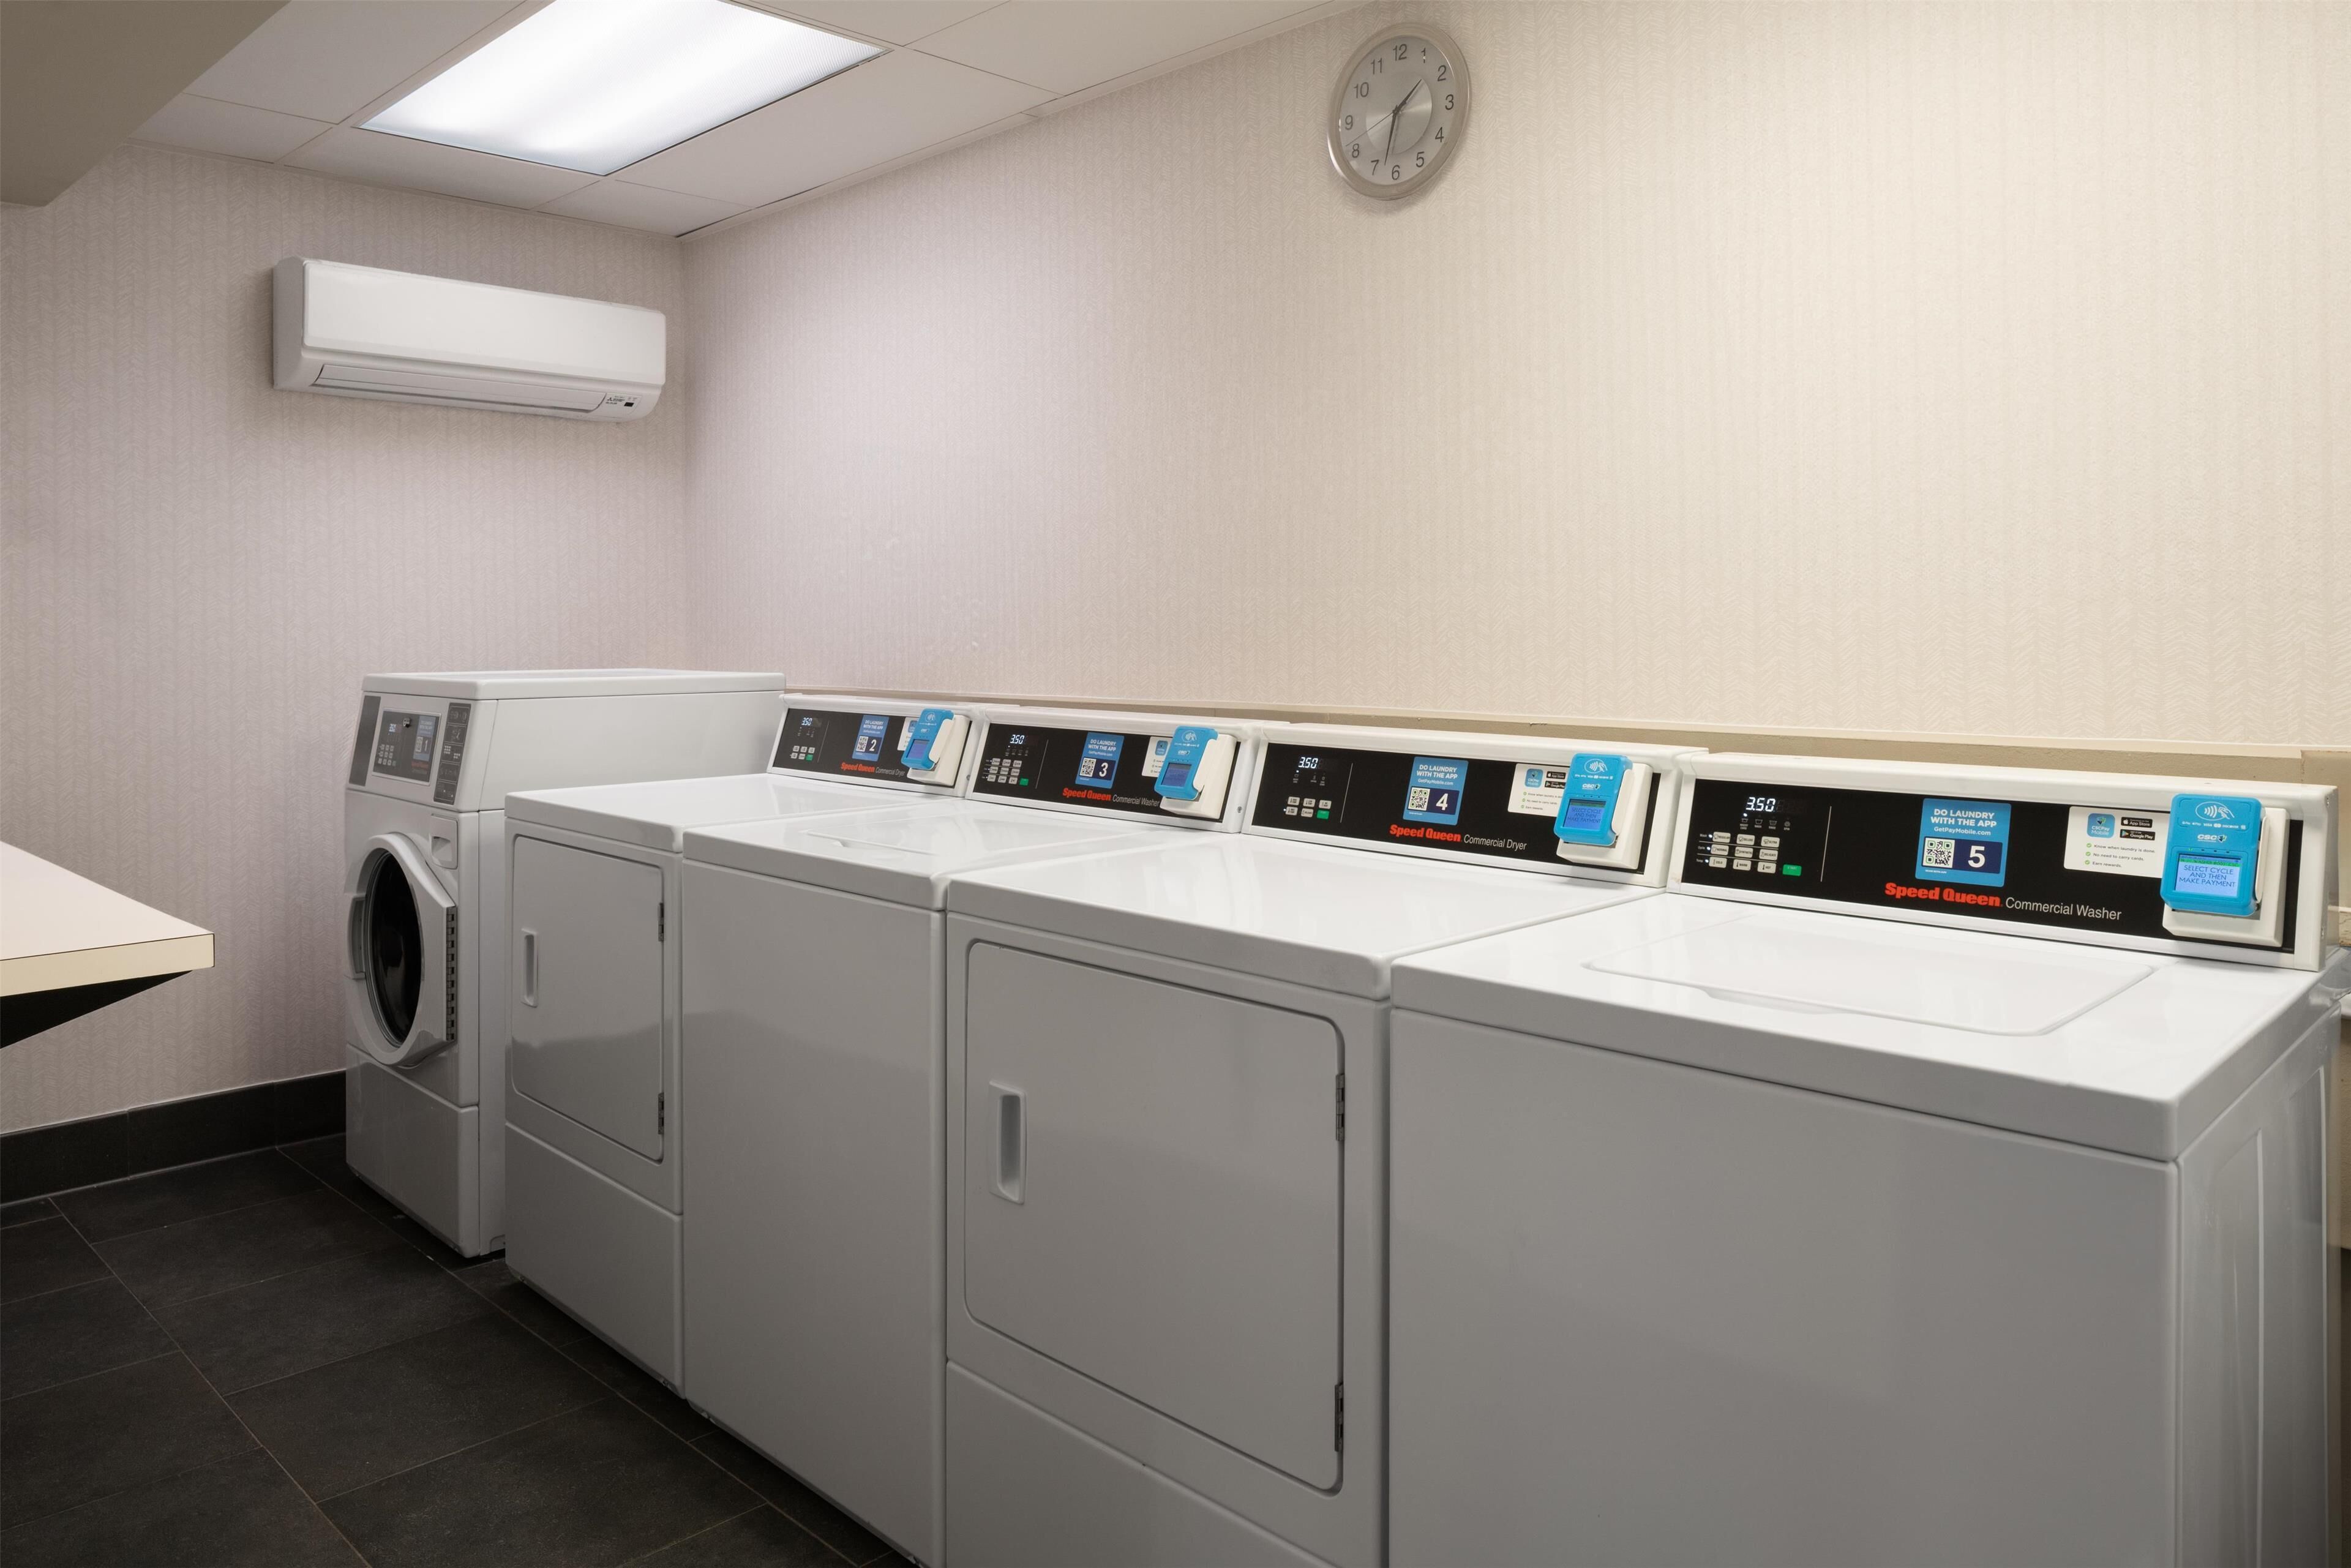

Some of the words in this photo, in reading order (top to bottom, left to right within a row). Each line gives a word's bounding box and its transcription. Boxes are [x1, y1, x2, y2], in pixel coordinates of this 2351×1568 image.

[1393, 43, 1408, 61] 12
[1421, 48, 1426, 63] 1
[1371, 58, 1382, 75] 11
[1437, 65, 1447, 81] 2
[1354, 82, 1369, 98] 10
[1445, 94, 1454, 110] 3
[1345, 115, 1353, 130] 9
[1435, 127, 1444, 142] 4
[1352, 143, 1360, 158] 8
[1415, 151, 1425, 167] 5
[1371, 159, 1379, 176] 7
[1392, 165, 1400, 180] 6
[869, 739, 877, 751] 2
[858, 763, 875, 773] Queen
[1099, 762, 1108, 777] 3
[1299, 757, 1318, 768] 3.50
[1062, 787, 1087, 798] Speed
[1087, 790, 1111, 801] Queen
[1112, 794, 1141, 805] Commercial
[1141, 798, 1160, 806] Washer
[1436, 793, 1448, 811] 4
[1745, 797, 1775, 812] 3.50
[1931, 816, 1955, 825] WITH
[1957, 818, 1976, 827] THE
[1977, 819, 1997, 828] APP
[1950, 809, 1995, 820] LAUNDRY
[1389, 823, 1424, 838] Speed
[1425, 828, 1461, 842] Queen
[1463, 834, 1505, 847] Commercial
[1507, 839, 1528, 852] Dryer
[1934, 826, 1991, 836] GetPayMobile.com
[1968, 845, 1985, 868] 5
[2202, 879, 2235, 887] PAYMENT
[1884, 882, 1940, 900] Speed
[1943, 888, 2001, 907] Queen
[2005, 897, 2072, 915] Commercial
[2075, 904, 2122, 920] Washer
